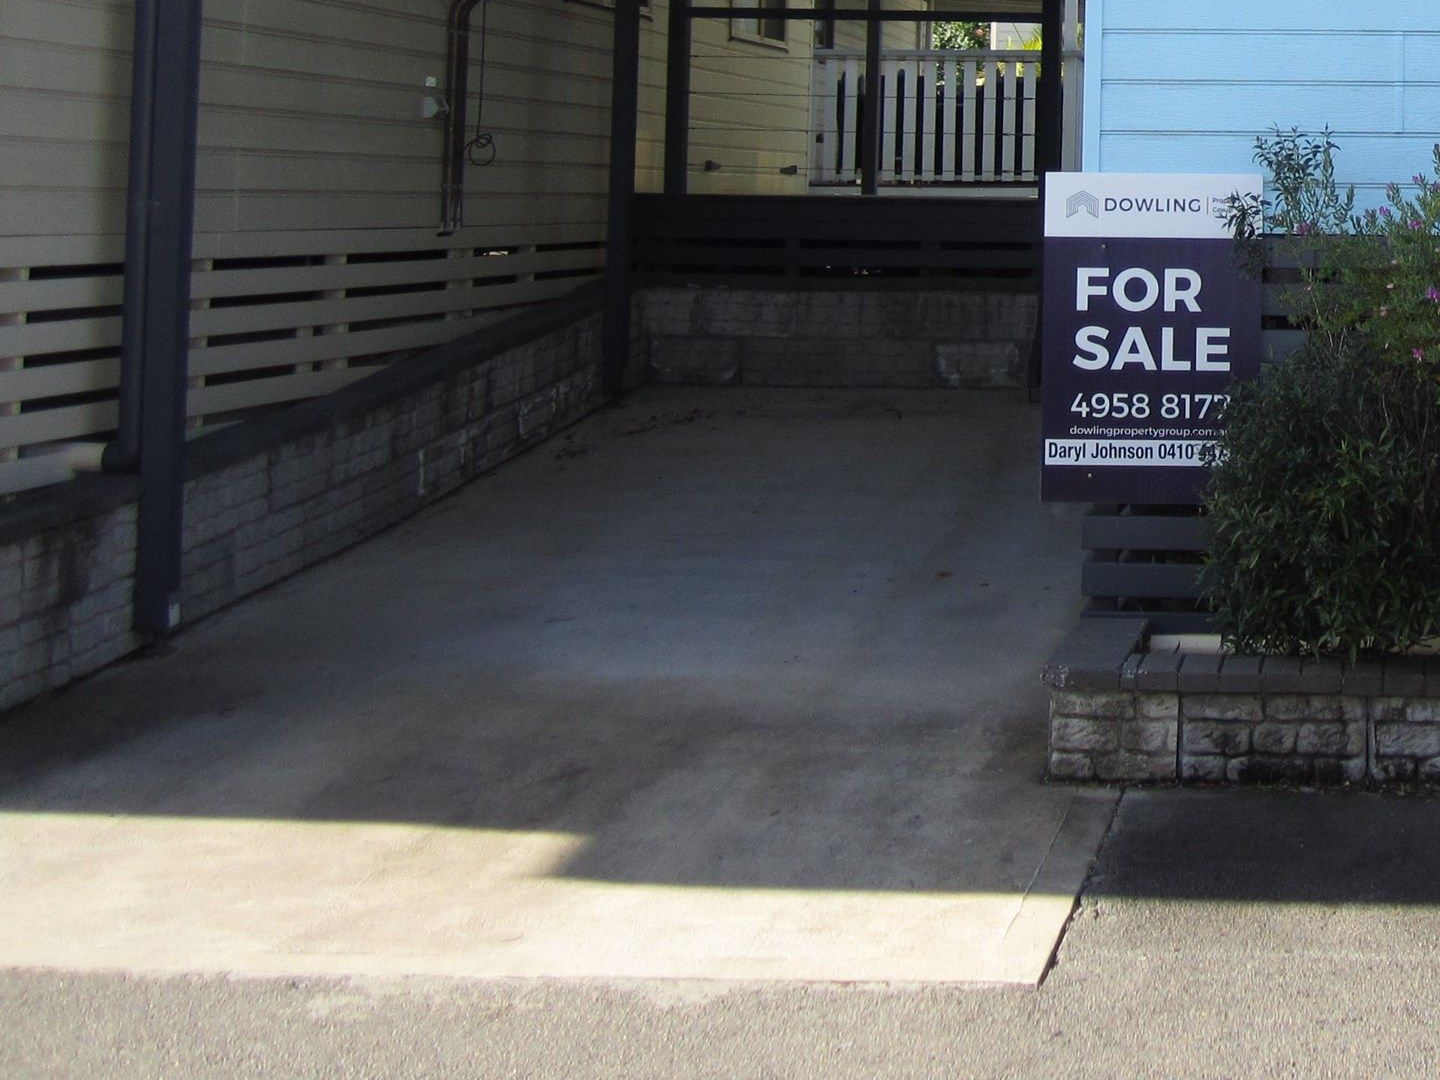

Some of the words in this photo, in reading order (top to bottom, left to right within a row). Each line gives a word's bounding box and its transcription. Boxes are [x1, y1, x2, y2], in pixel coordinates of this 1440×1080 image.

[1104, 197, 1201, 213] DOWLING
[1076, 267, 1202, 312] FOR
[1072, 325, 1231, 371] SALE
[1070, 392, 1151, 419] 4958
[1048, 442, 1086, 462] Daryl
[1091, 442, 1153, 459] Johnson
[1158, 443, 1194, 460] 0410
